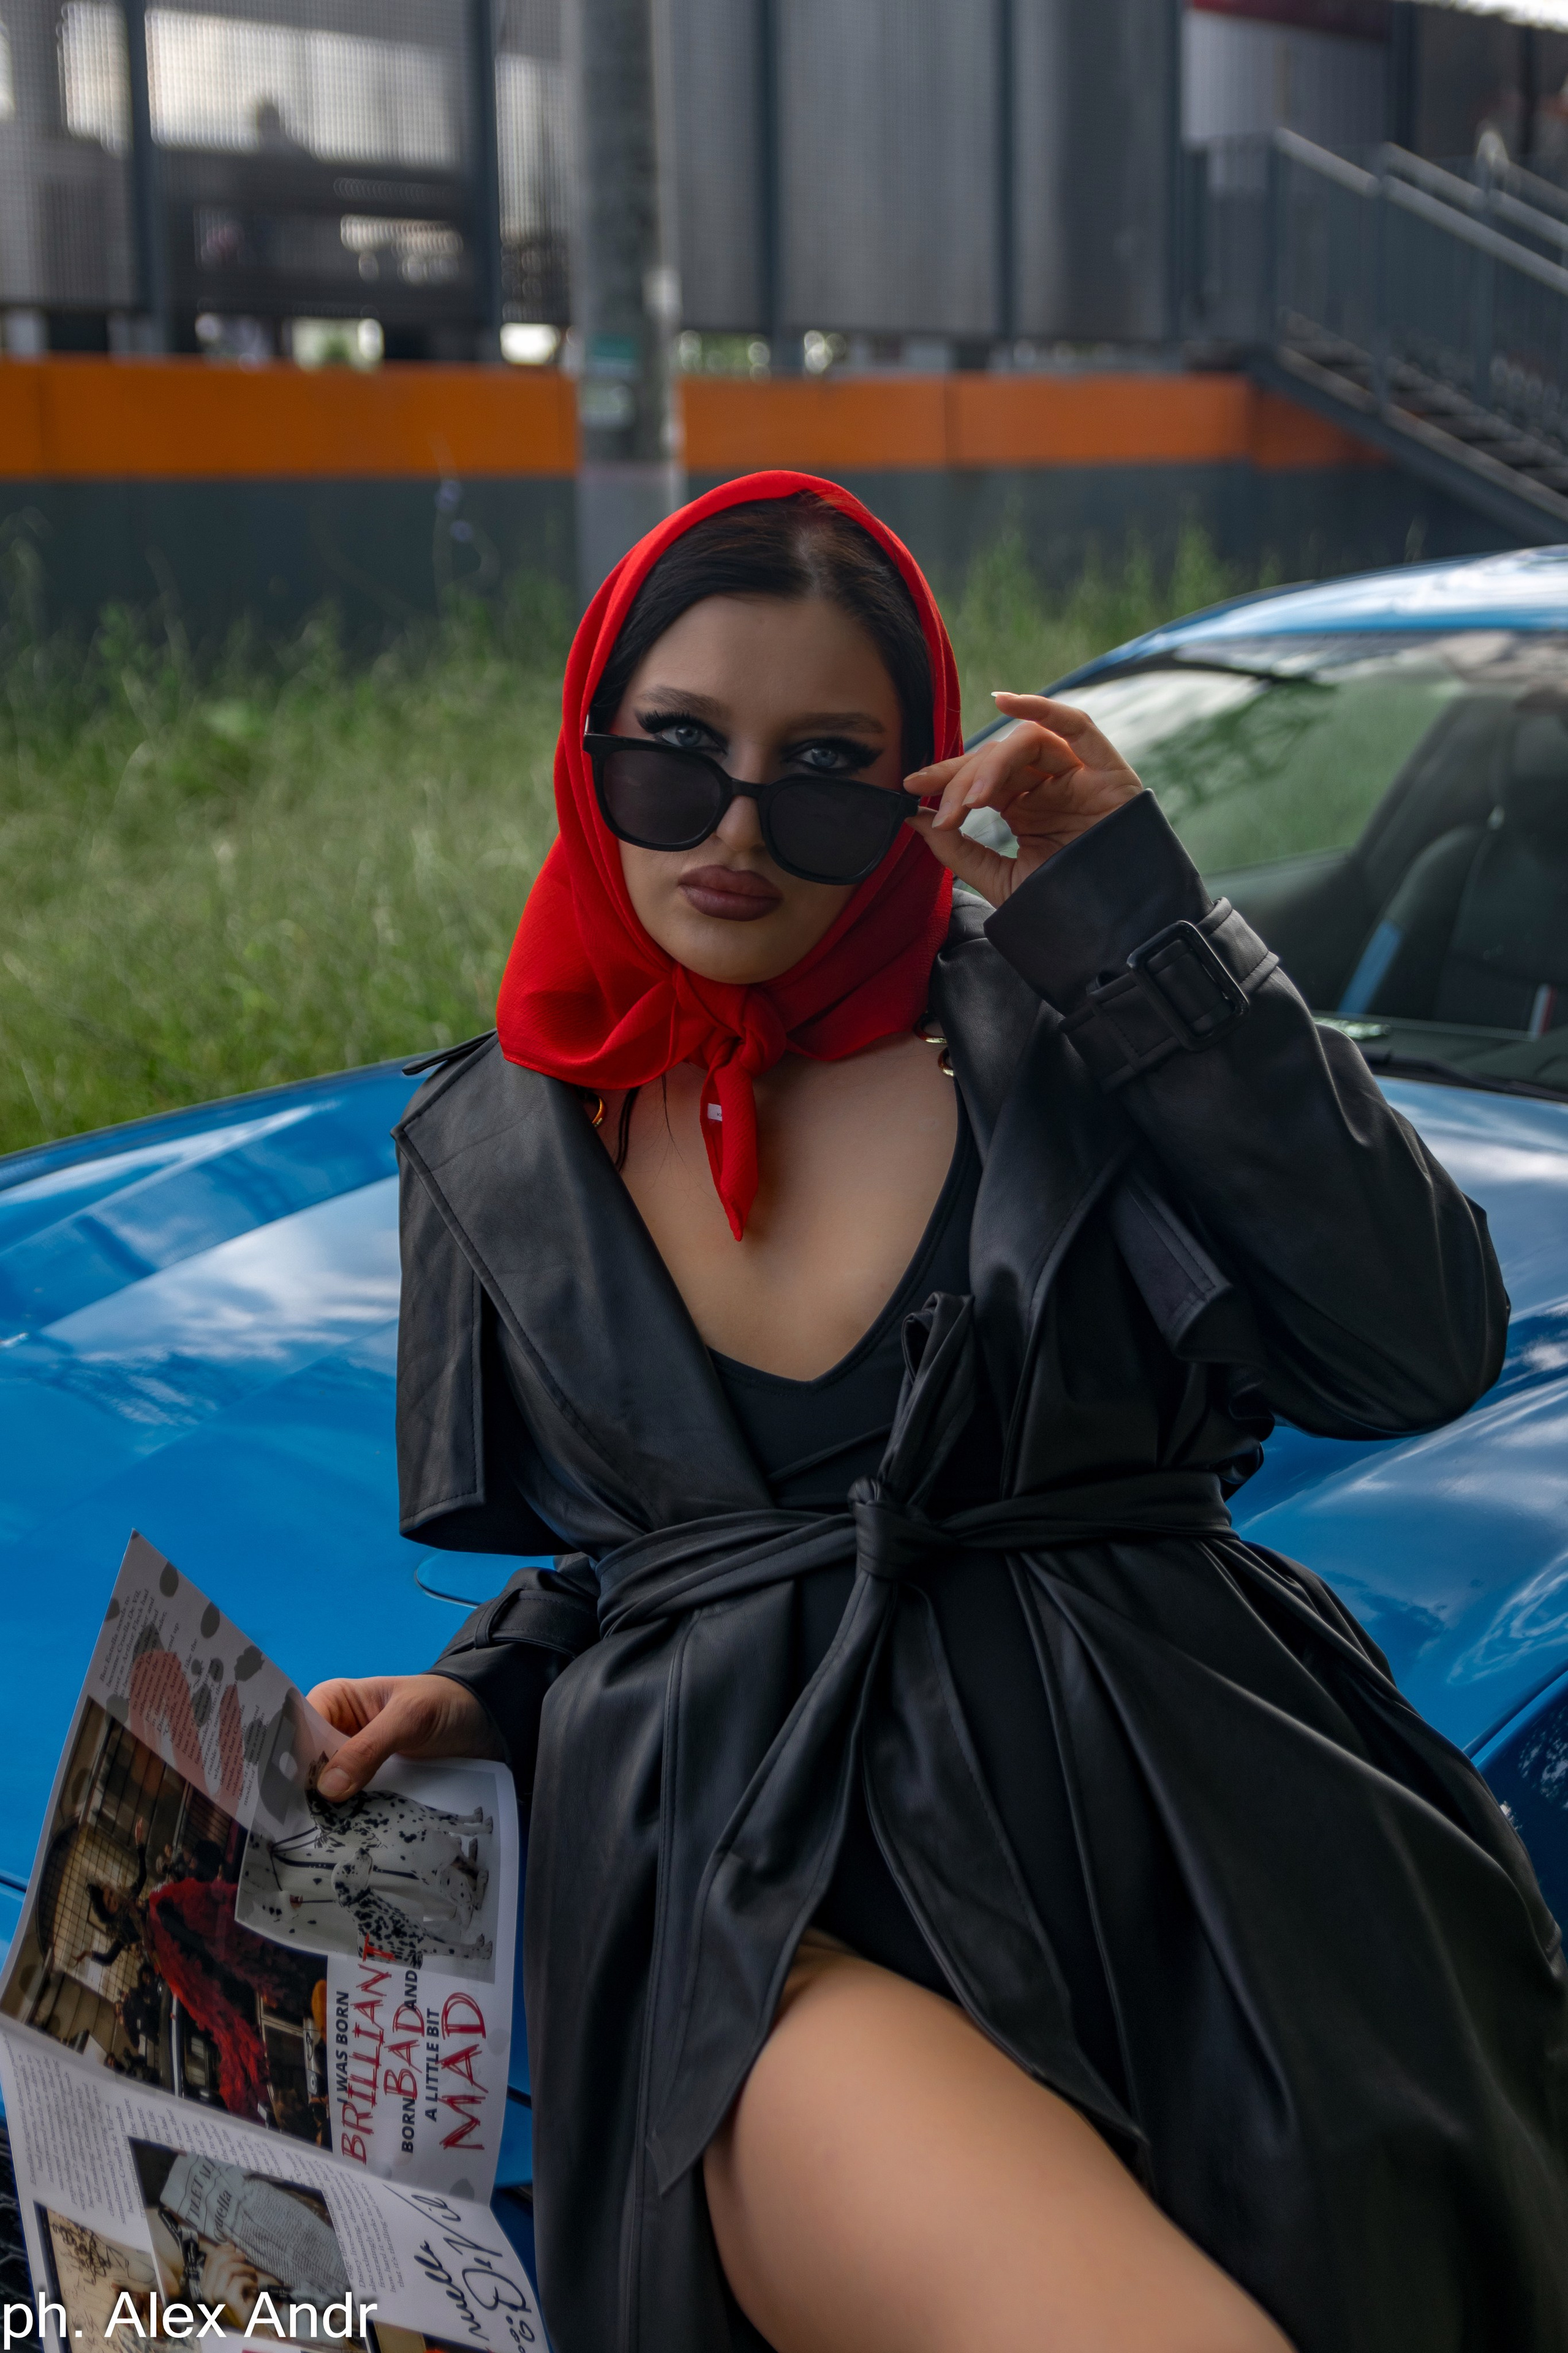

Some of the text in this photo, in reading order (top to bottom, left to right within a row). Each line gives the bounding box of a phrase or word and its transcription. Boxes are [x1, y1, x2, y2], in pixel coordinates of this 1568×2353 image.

[99, 1595, 130, 1682] But Estella needs to
[105, 1604, 135, 1688] become Cruella De
[112, 1587, 149, 1695] just as Arthur Fleck had
[118, 1688, 125, 1699] to
[122, 1656, 135, 1688] become
[145, 1596, 155, 1615] and
[124, 1607, 159, 1705] Anakin had
[175, 1635, 198, 1695] much like the
[131, 1637, 157, 1711] to become Darth
[137, 1656, 159, 1717] otherwise the
[143, 1621, 180, 1723] production can't end up
[150, 1650, 177, 1727] in theaters and on
[168, 1661, 182, 1691] And so
[187, 1740, 197, 1760] lore
[192, 1723, 202, 1742] and
[211, 1663, 221, 1682] and
[194, 1679, 222, 1766] fanwankery into the
[212, 1707, 222, 1728] none
[219, 1683, 230, 1707] more
[181, 1727, 192, 1754] has to
[206, 1711, 228, 1775] risible than the
[211, 1704, 238, 1781] where the heroine
[218, 1702, 246, 1786] decides that Cruella
[224, 1723, 249, 1792] needs an equally
[229, 1762, 244, 1797] colorful
[245, 1721, 256, 1745] name
[236, 1779, 246, 1801] takes
[243, 1769, 249, 1778] it
[242, 1767, 257, 1806] model of
[336, 1991, 349, 2045] BORN
[12, 2068, 18, 2078] to
[42, 2055, 55, 2089] that the
[335, 2050, 348, 2092] WAS
[341, 1932, 396, 2165] BRILLIANT
[383, 1970, 425, 2153] BORN BAD AND
[424, 2008, 439, 2122] A LITTLE BIT
[435, 1992, 488, 2150] MAD
[81, 2082, 91, 2100] and
[85, 2099, 97, 2124] right
[123, 2098, 138, 2136] the more
[79, 2118, 92, 2150] Estella
[91, 2083, 127, 2225] simultaneously setting her up to
[94, 2146, 103, 2162] her
[146, 2109, 161, 2141] real life
[157, 2115, 173, 2144] for bad
[173, 2126, 182, 2141] use
[190, 2123, 200, 2136] the
[218, 2147, 230, 2161] the
[97, 2162, 105, 2174] in
[110, 2132, 134, 2214] become Cruella de
[113, 2104, 147, 2219] transformation that makes
[100, 2173, 115, 2217] character
[213, 2189, 232, 2243] Cruella
[366, 2207, 373, 2217] to
[325, 2200, 356, 2280] edge that's unusual
[339, 2211, 367, 2289] Disney live-action
[353, 2224, 377, 2292] also exhausting,
[368, 2217, 382, 2242] works
[379, 2219, 405, 2288] that it's thrilling
[364, 2234, 386, 2288] frustratingly
[379, 2252, 391, 2273] hard
[386, 2273, 396, 2293] how
